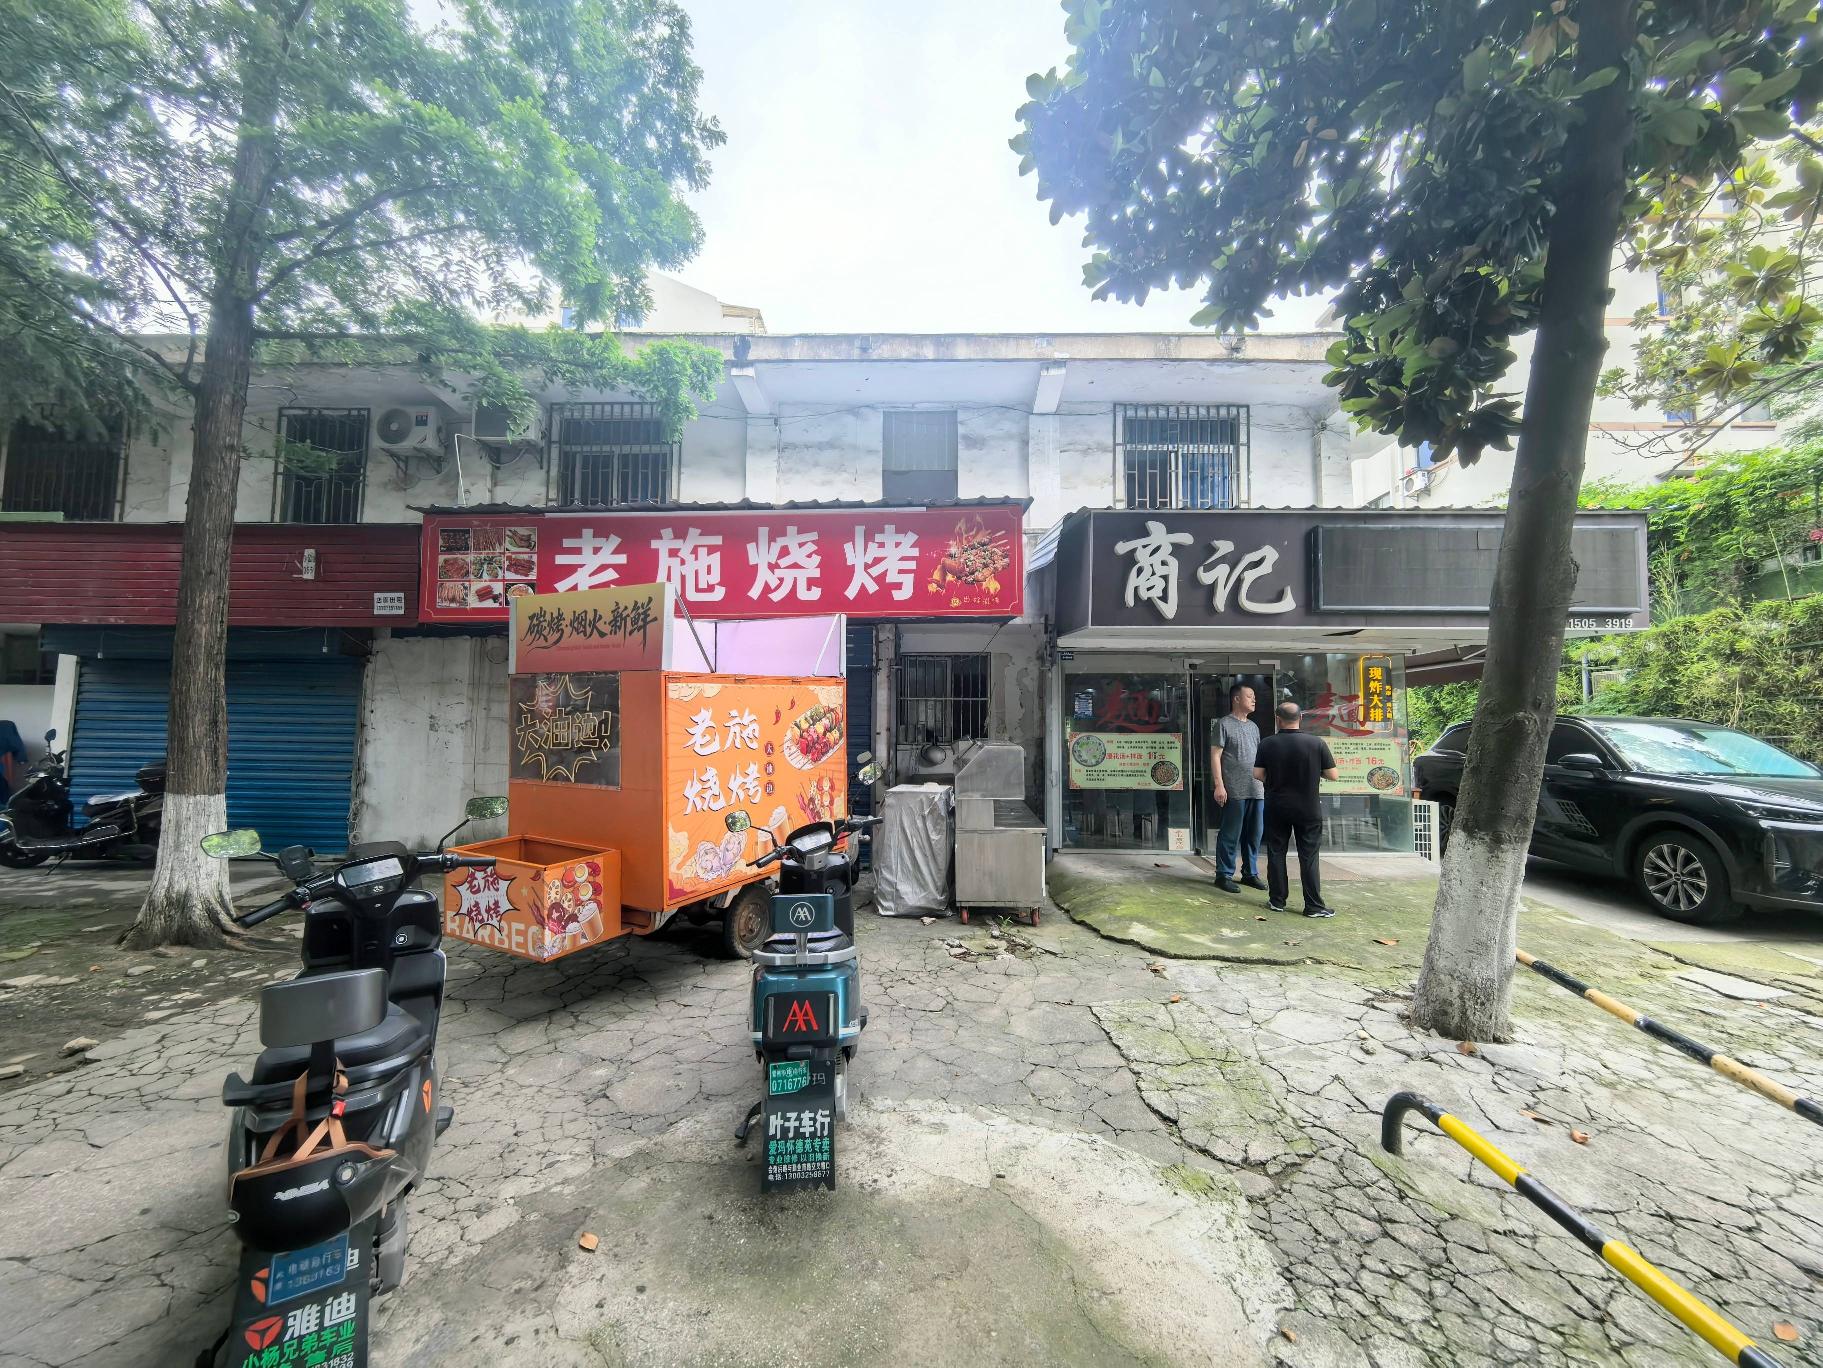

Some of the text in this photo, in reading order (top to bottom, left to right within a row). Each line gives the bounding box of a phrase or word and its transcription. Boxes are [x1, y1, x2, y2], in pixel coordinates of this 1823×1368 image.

[554, 525, 920, 601] 老施烧烤
[1115, 520, 1296, 620] 商记
[1605, 618, 1633, 629] 3919
[1368, 666, 1384, 722] 现炸大排
[680, 707, 760, 756] 老施
[682, 762, 762, 815] 烧烤
[772, 1076, 807, 1091] 0716776
[768, 1109, 831, 1139] 叶子车行
[283, 1291, 357, 1342] 雅迪
[241, 1319, 356, 1368] 小杨兄弟车业
